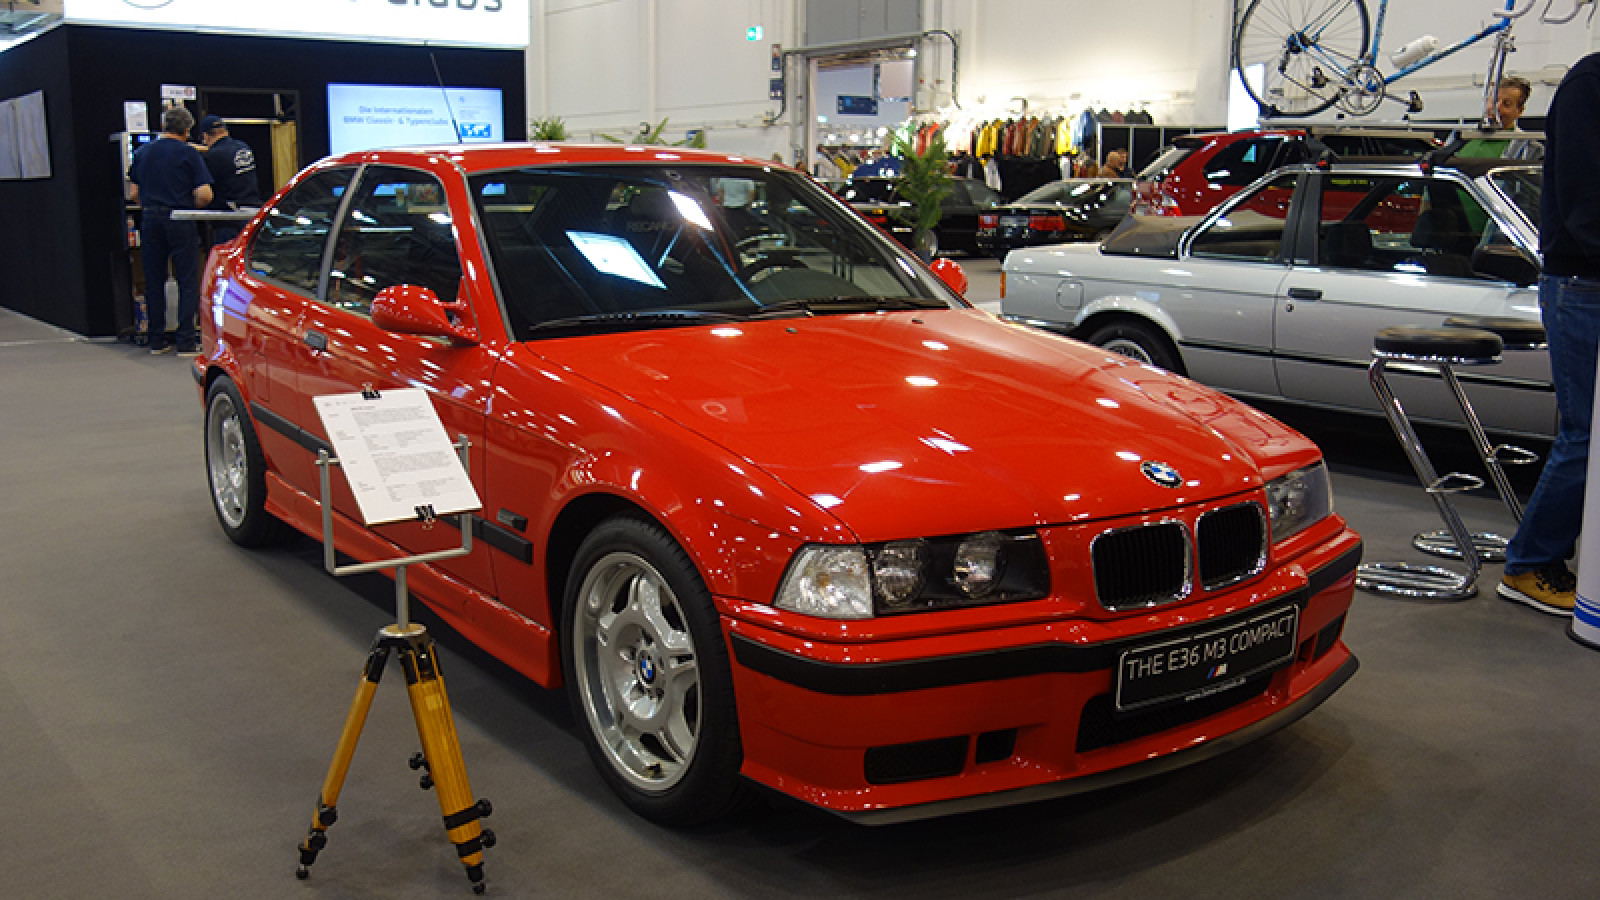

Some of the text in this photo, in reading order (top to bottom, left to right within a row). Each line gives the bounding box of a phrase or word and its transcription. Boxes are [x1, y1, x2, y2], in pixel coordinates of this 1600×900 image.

[1126, 653, 1164, 681] THE
[1167, 644, 1201, 671] E36
[1203, 637, 1228, 662] M3
[1229, 614, 1295, 655] COMPACT
